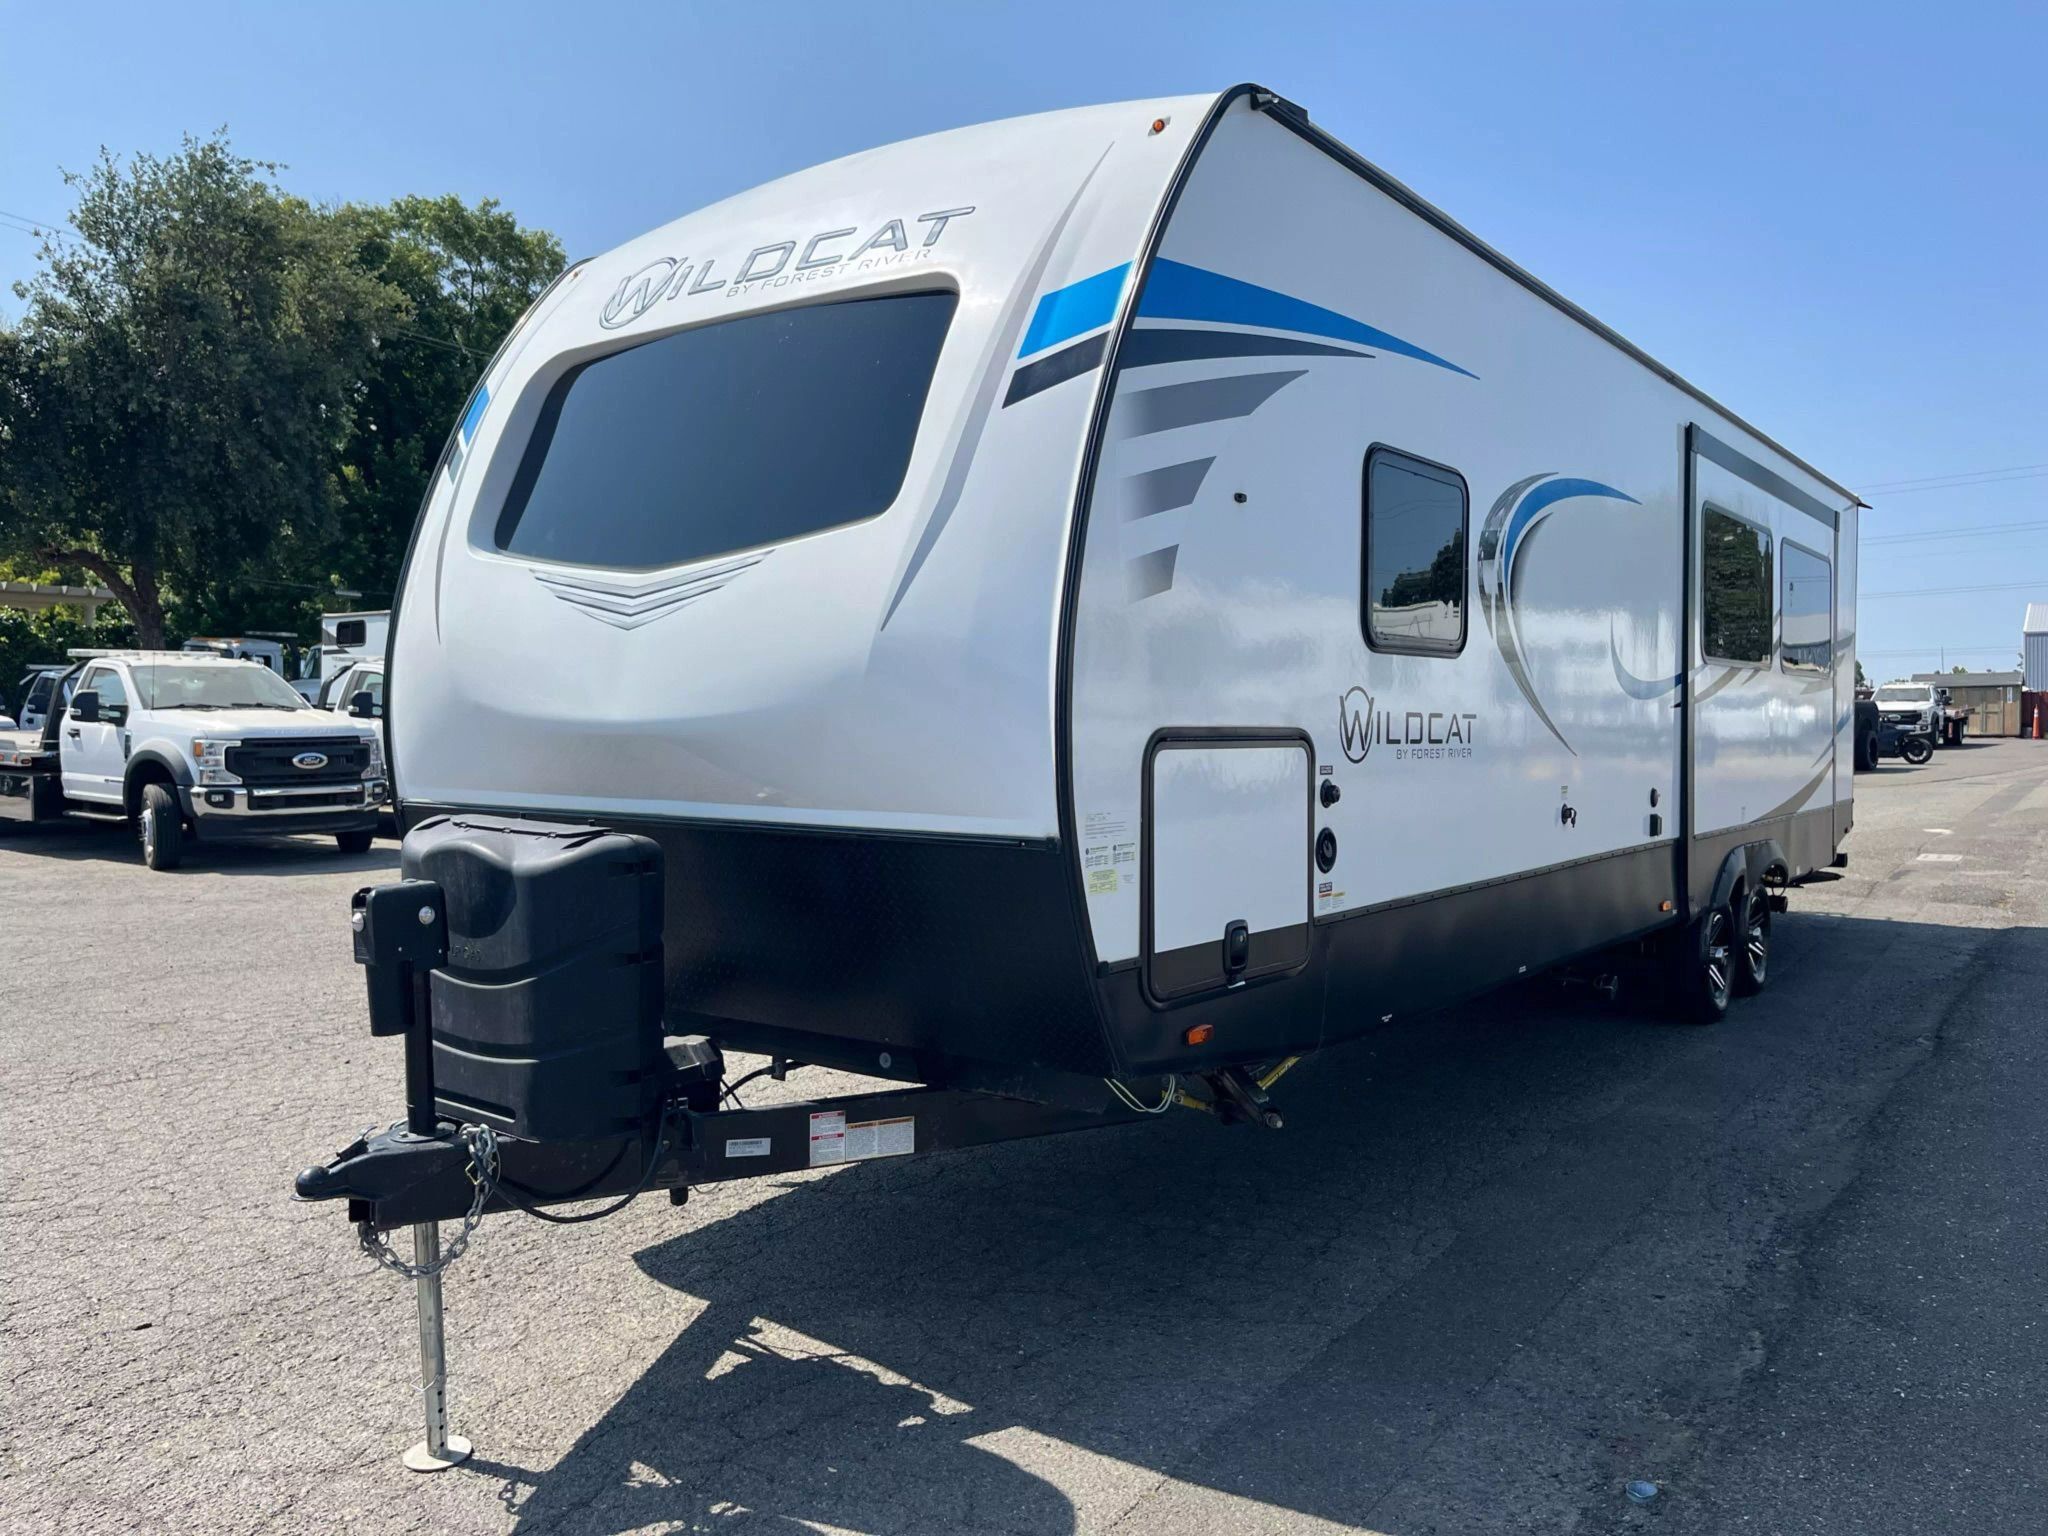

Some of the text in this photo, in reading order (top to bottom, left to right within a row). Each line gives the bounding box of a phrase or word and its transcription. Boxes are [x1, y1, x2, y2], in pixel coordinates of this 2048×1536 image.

[600, 206, 976, 329] WILDCAT
[727, 249, 931, 298] BY FOREST RIVER
[1340, 686, 1477, 764] WILDCAT
[1396, 748, 1472, 760] BY FOREST RIVER
